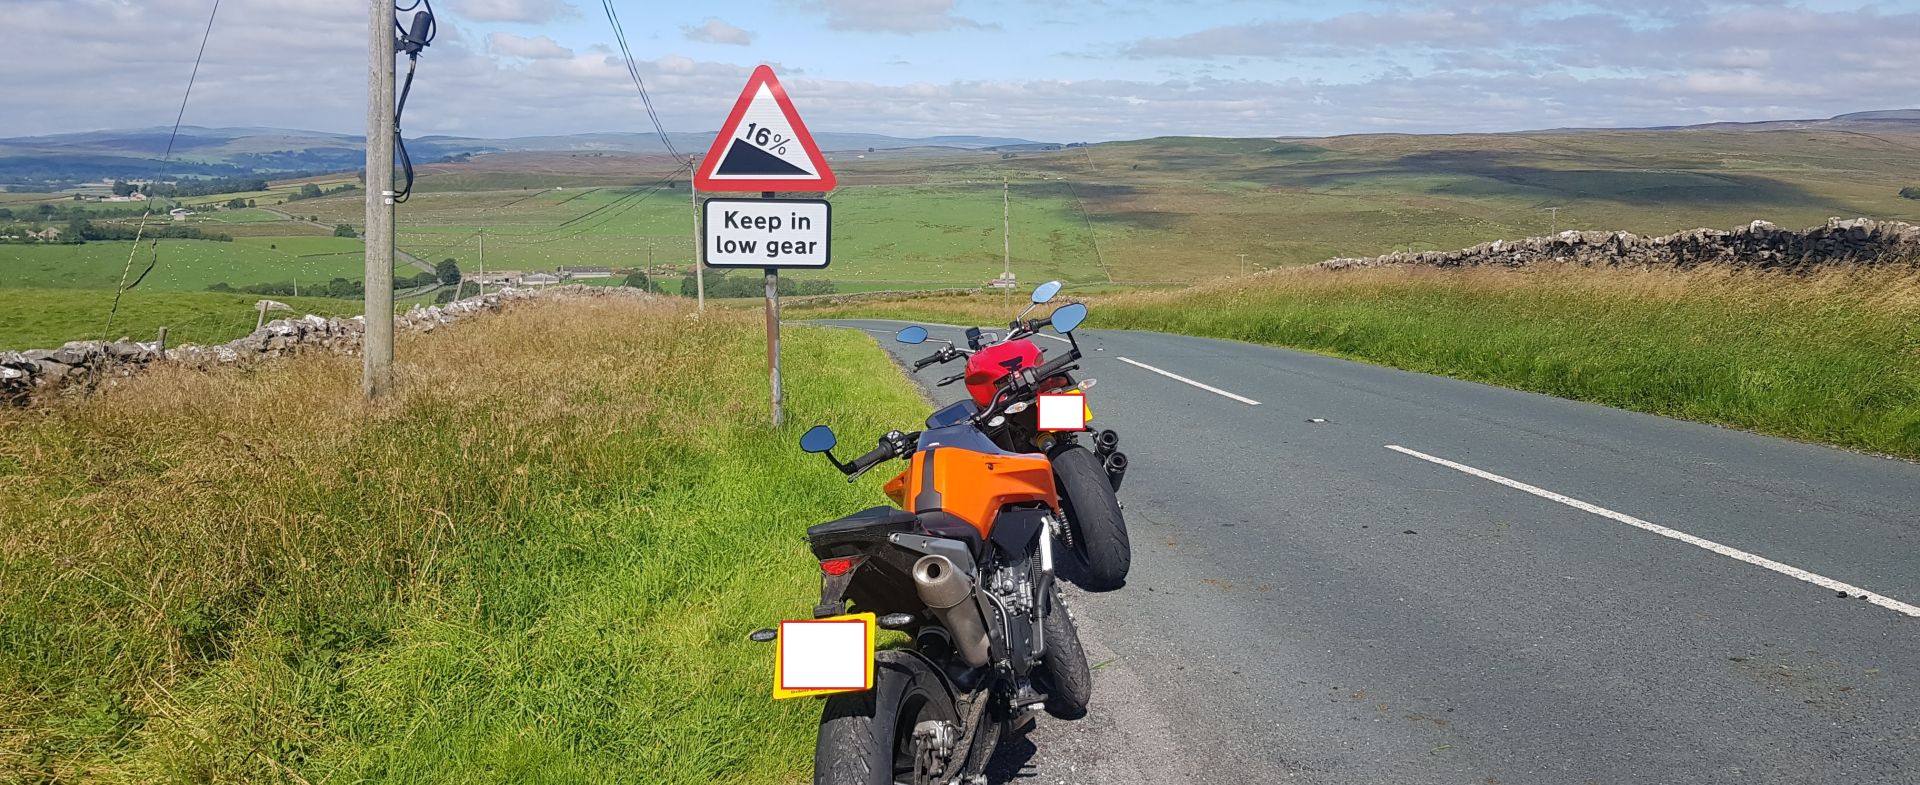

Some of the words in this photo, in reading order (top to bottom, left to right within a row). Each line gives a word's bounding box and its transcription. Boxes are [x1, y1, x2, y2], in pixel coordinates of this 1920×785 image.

[746, 122, 791, 156] 16%
[724, 210, 782, 233] Keep
[791, 211, 811, 230] in
[716, 235, 757, 255] low
[766, 239, 818, 258] gear
